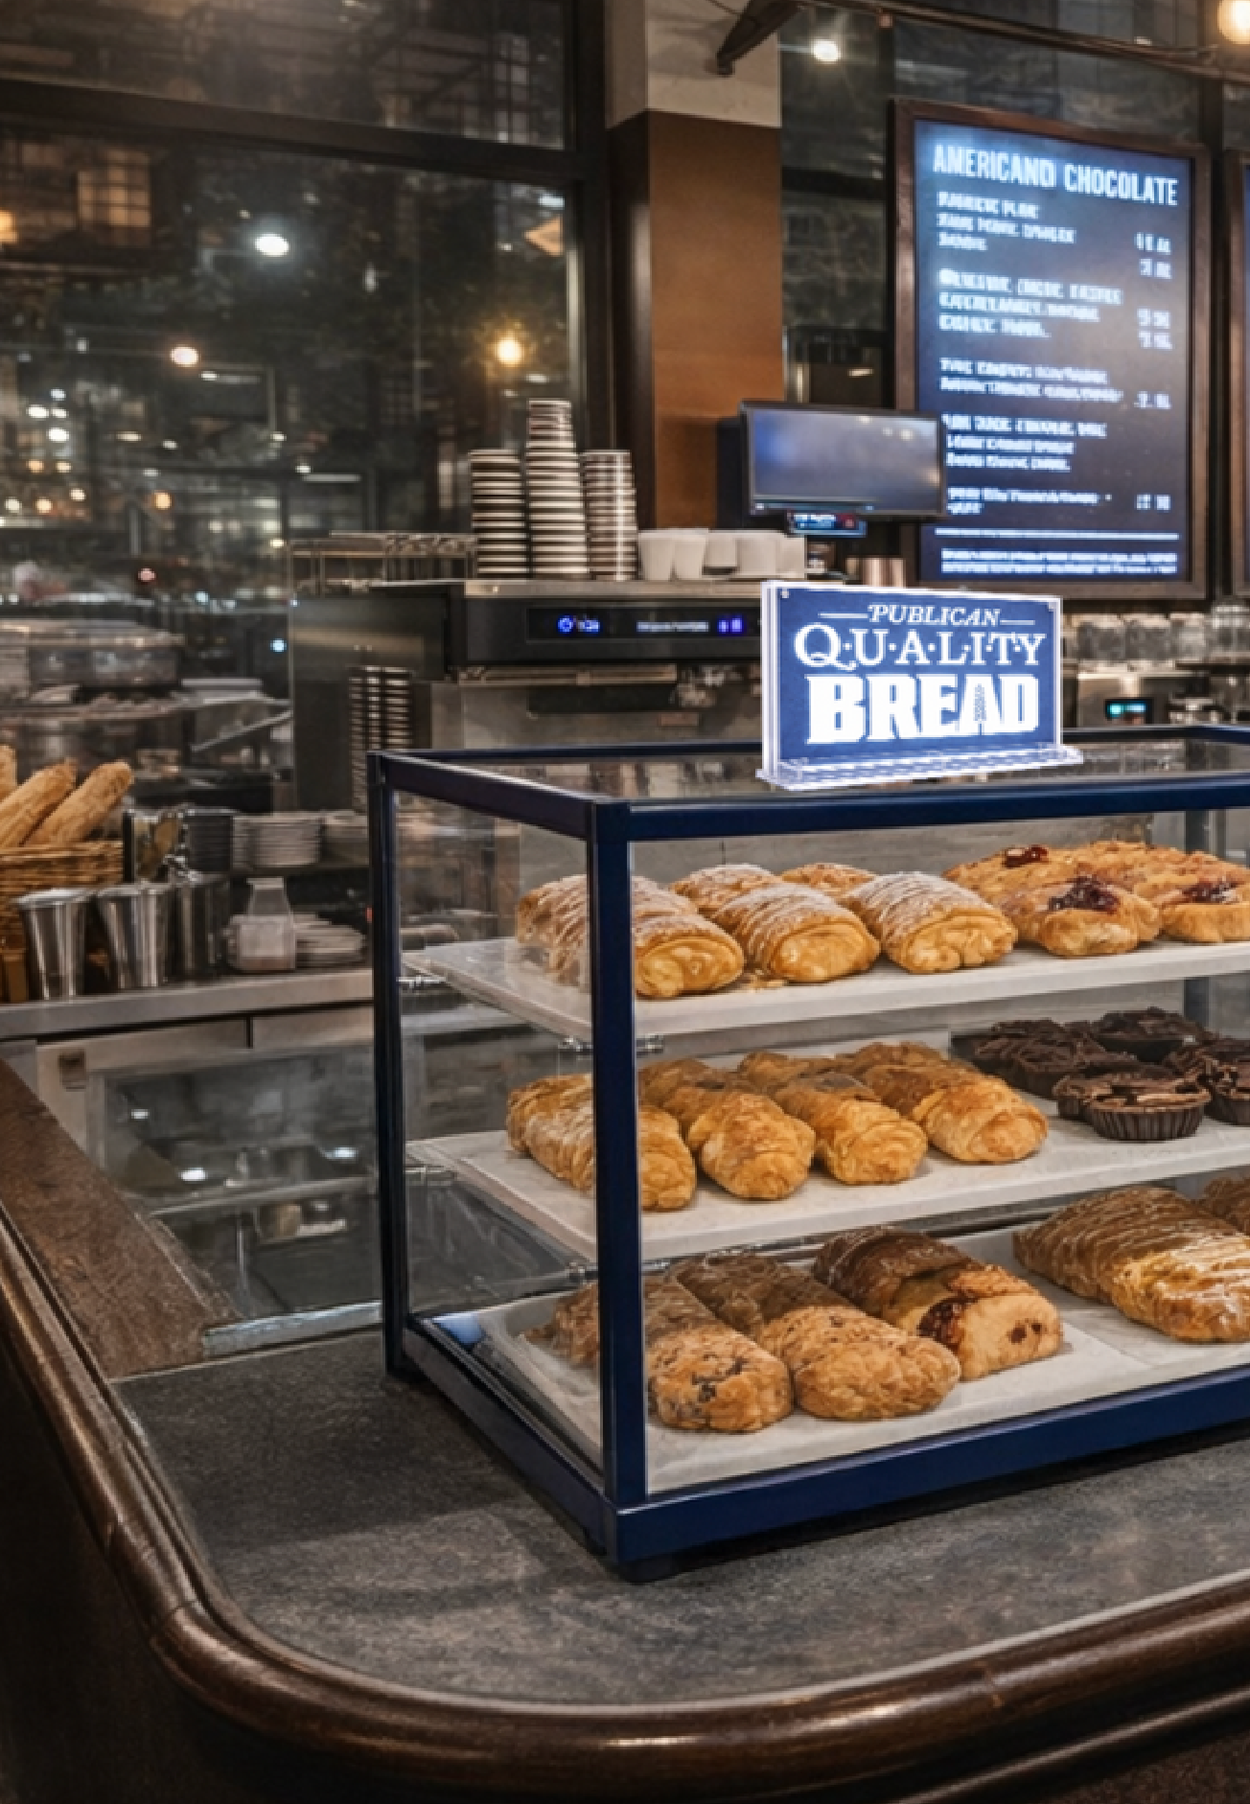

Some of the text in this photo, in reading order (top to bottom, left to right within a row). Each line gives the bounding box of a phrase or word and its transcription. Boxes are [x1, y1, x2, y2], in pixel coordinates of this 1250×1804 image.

[1064, 163, 1178, 206] CHOCOLATE
[867, 604, 1000, 627] PUBLICAN
[804, 673, 1039, 745] BREAD
